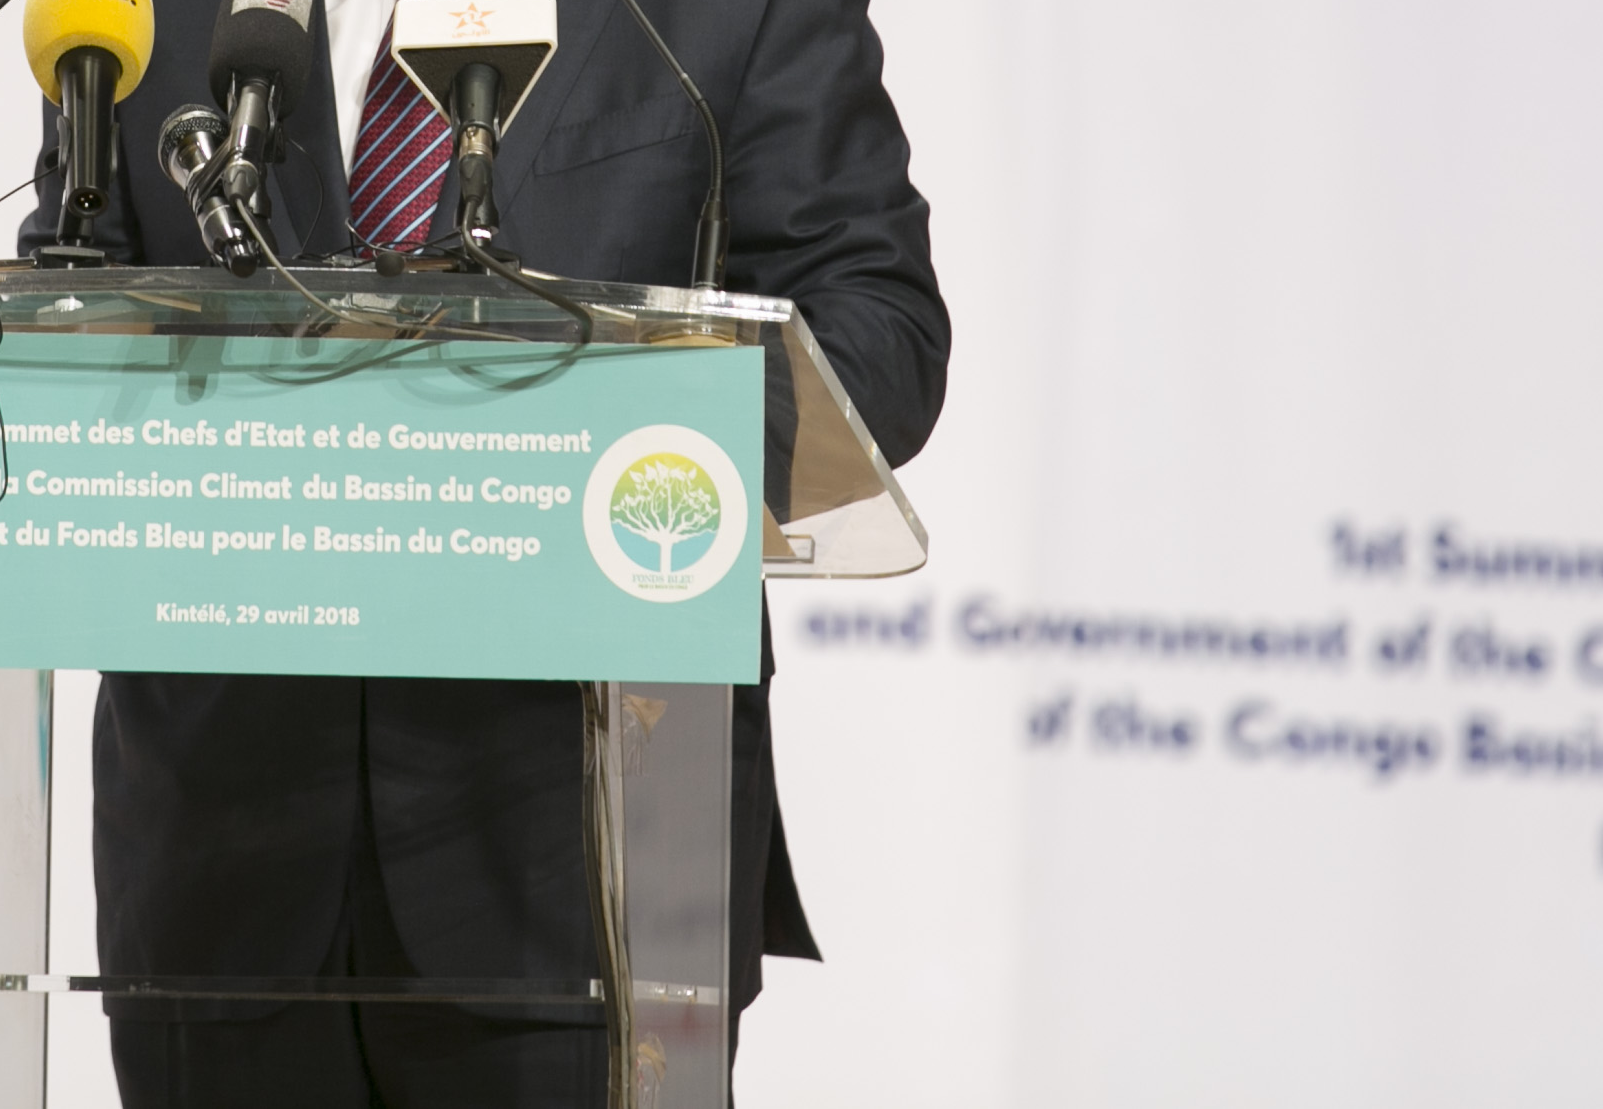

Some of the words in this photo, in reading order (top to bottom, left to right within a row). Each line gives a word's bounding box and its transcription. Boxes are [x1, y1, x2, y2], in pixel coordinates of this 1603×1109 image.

[88, 418, 135, 445] des
[141, 419, 219, 446] Chefs
[224, 420, 306, 448] d'Etat
[312, 424, 341, 449] et
[346, 422, 382, 449] de
[388, 423, 592, 454] Gouvernement
[26, 470, 193, 498] Commission
[200, 472, 292, 500] Climat
[302, 473, 338, 500] du
[344, 475, 432, 502] Bassin
[438, 476, 474, 503] du
[480, 477, 572, 511] Congo
[15, 520, 50, 547] du
[57, 521, 139, 548] Fonds
[145, 522, 205, 549] Bleu
[211, 530, 276, 556] pour
[281, 525, 307, 552] le
[313, 526, 402, 553] Bassin
[408, 527, 443, 554] du
[449, 528, 541, 562] Congo
[156, 603, 231, 626] Kintélé,
[235, 604, 261, 624] 29
[264, 604, 310, 625] avril
[313, 606, 361, 626] 2018
